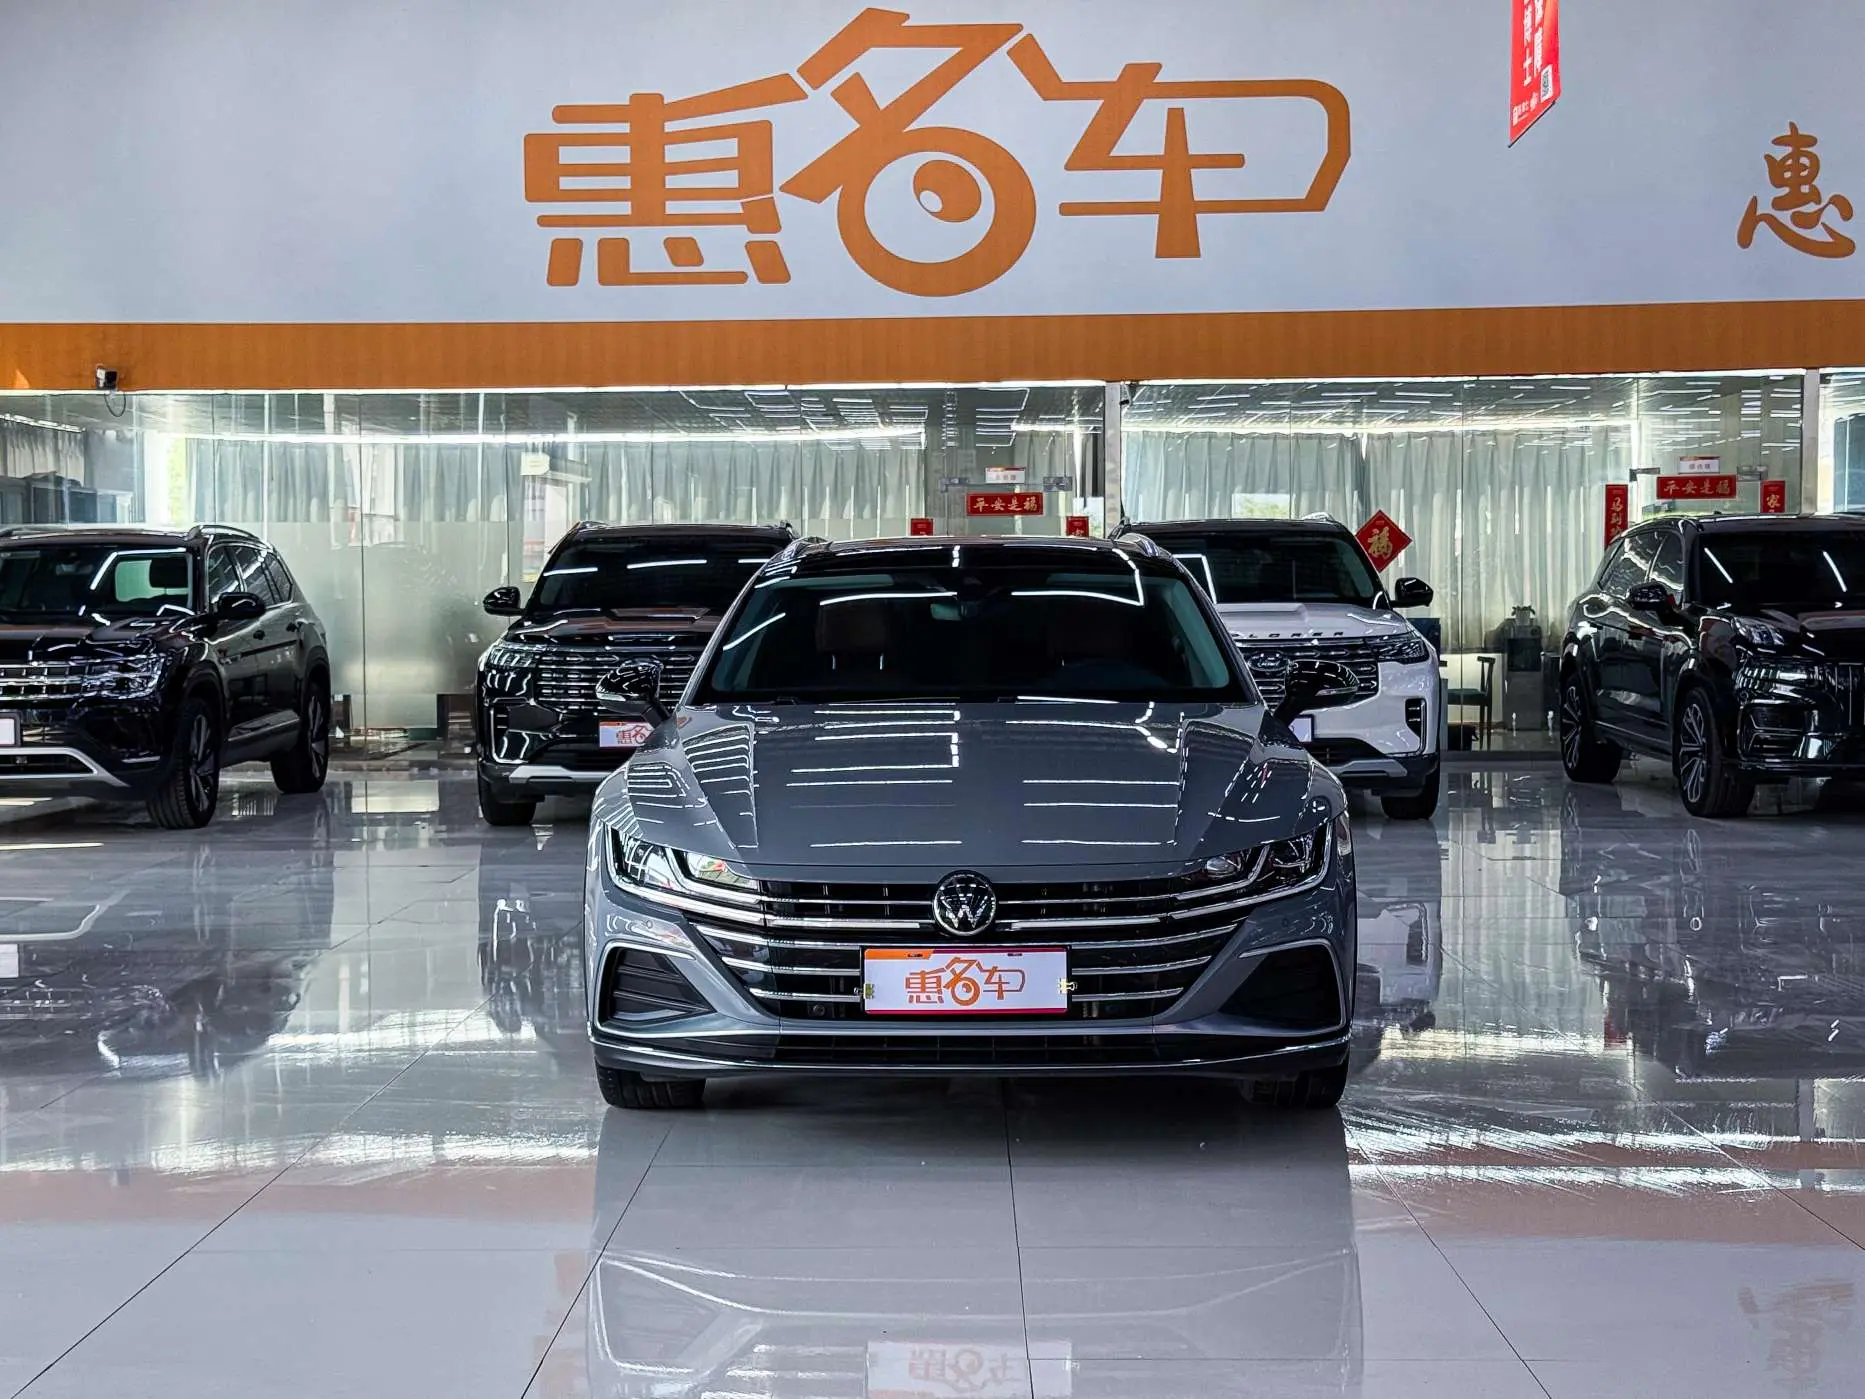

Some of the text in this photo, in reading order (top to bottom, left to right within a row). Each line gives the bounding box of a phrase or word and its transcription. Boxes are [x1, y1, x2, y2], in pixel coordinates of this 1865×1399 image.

[524, 7, 1351, 297] 惠名车
[972, 495, 1038, 513] 平安是福
[1367, 526, 1393, 559] 福
[905, 956, 1026, 1007] 惠名车
